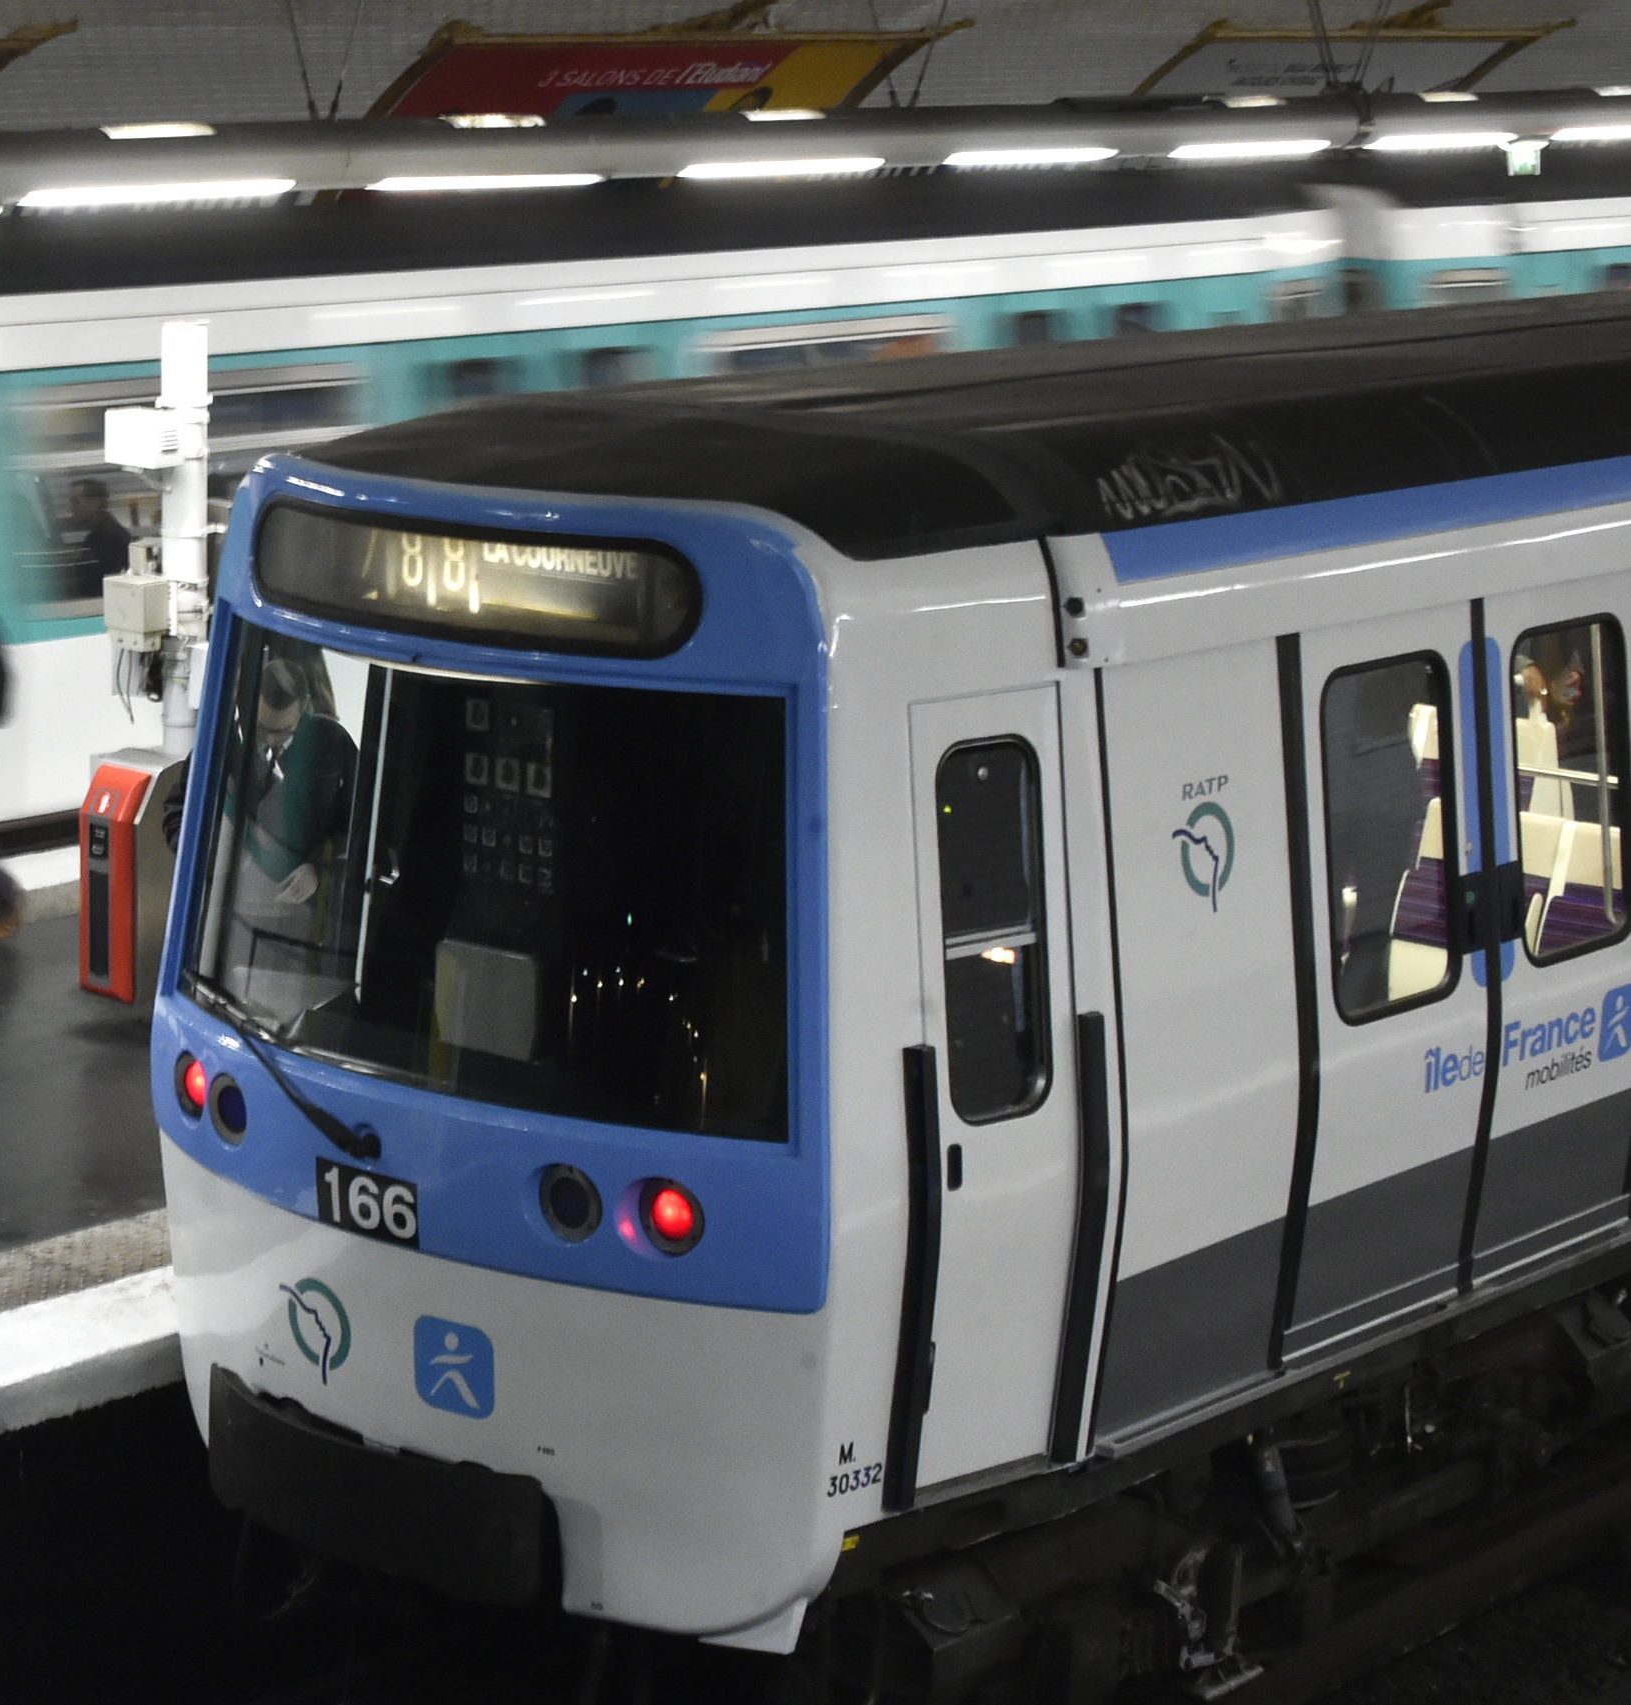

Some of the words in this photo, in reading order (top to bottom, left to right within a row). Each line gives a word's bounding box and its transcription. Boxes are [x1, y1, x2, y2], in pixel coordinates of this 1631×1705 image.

[557, 69, 646, 88] SALONS
[642, 69, 680, 86] DE
[1182, 774, 1229, 801] RATP
[1502, 1007, 1597, 1067] France
[1525, 1046, 1593, 1091] mobilités
[324, 1166, 417, 1239] 166
[827, 1462, 883, 1498] 30332
